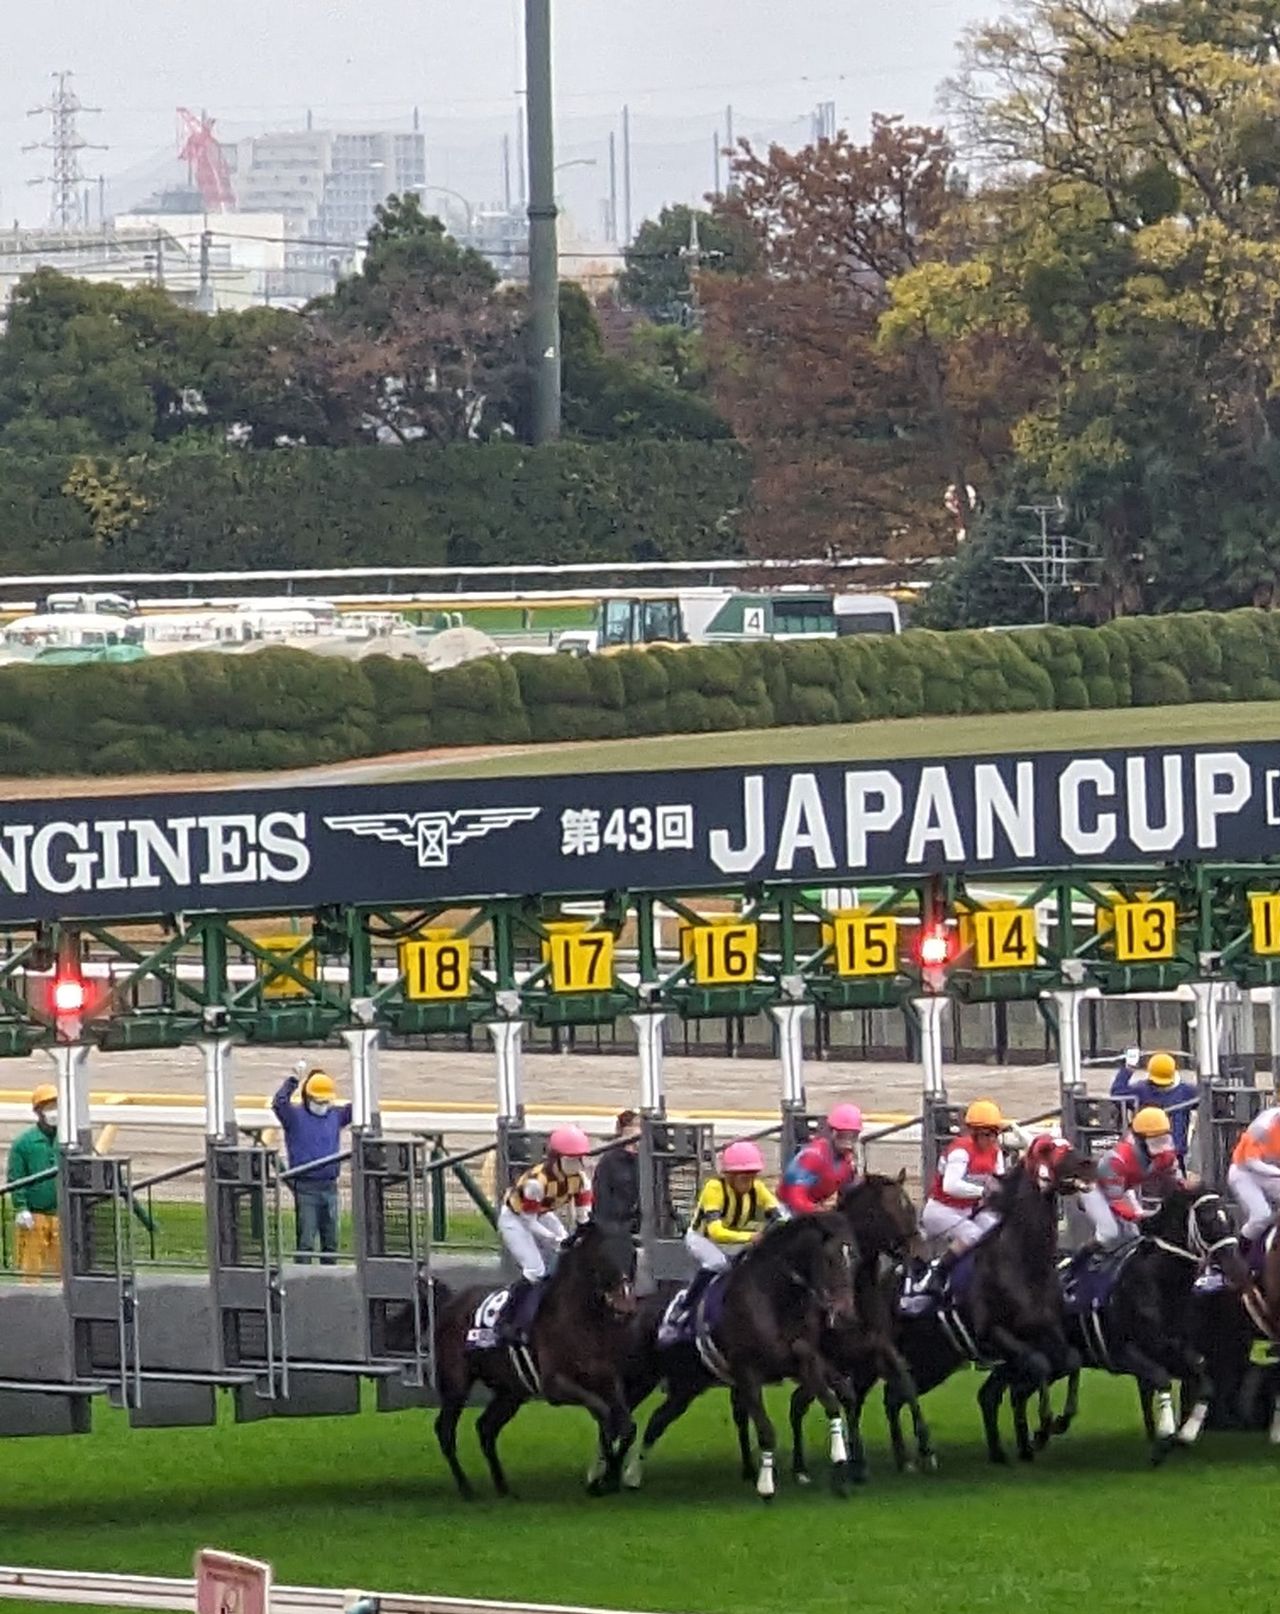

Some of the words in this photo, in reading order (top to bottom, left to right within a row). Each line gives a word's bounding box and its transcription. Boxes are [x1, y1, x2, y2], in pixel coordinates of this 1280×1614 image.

[747, 611, 760, 631] 4
[560, 804, 694, 856] 第43回
[708, 760, 1037, 874] JAPAN
[1058, 751, 1252, 855] CUP
[707, 930, 747, 978] 16
[847, 922, 888, 970] 15
[988, 915, 1028, 962] 14
[1127, 908, 1166, 954] 13
[418, 946, 460, 993] 18
[564, 938, 604, 986] 17
